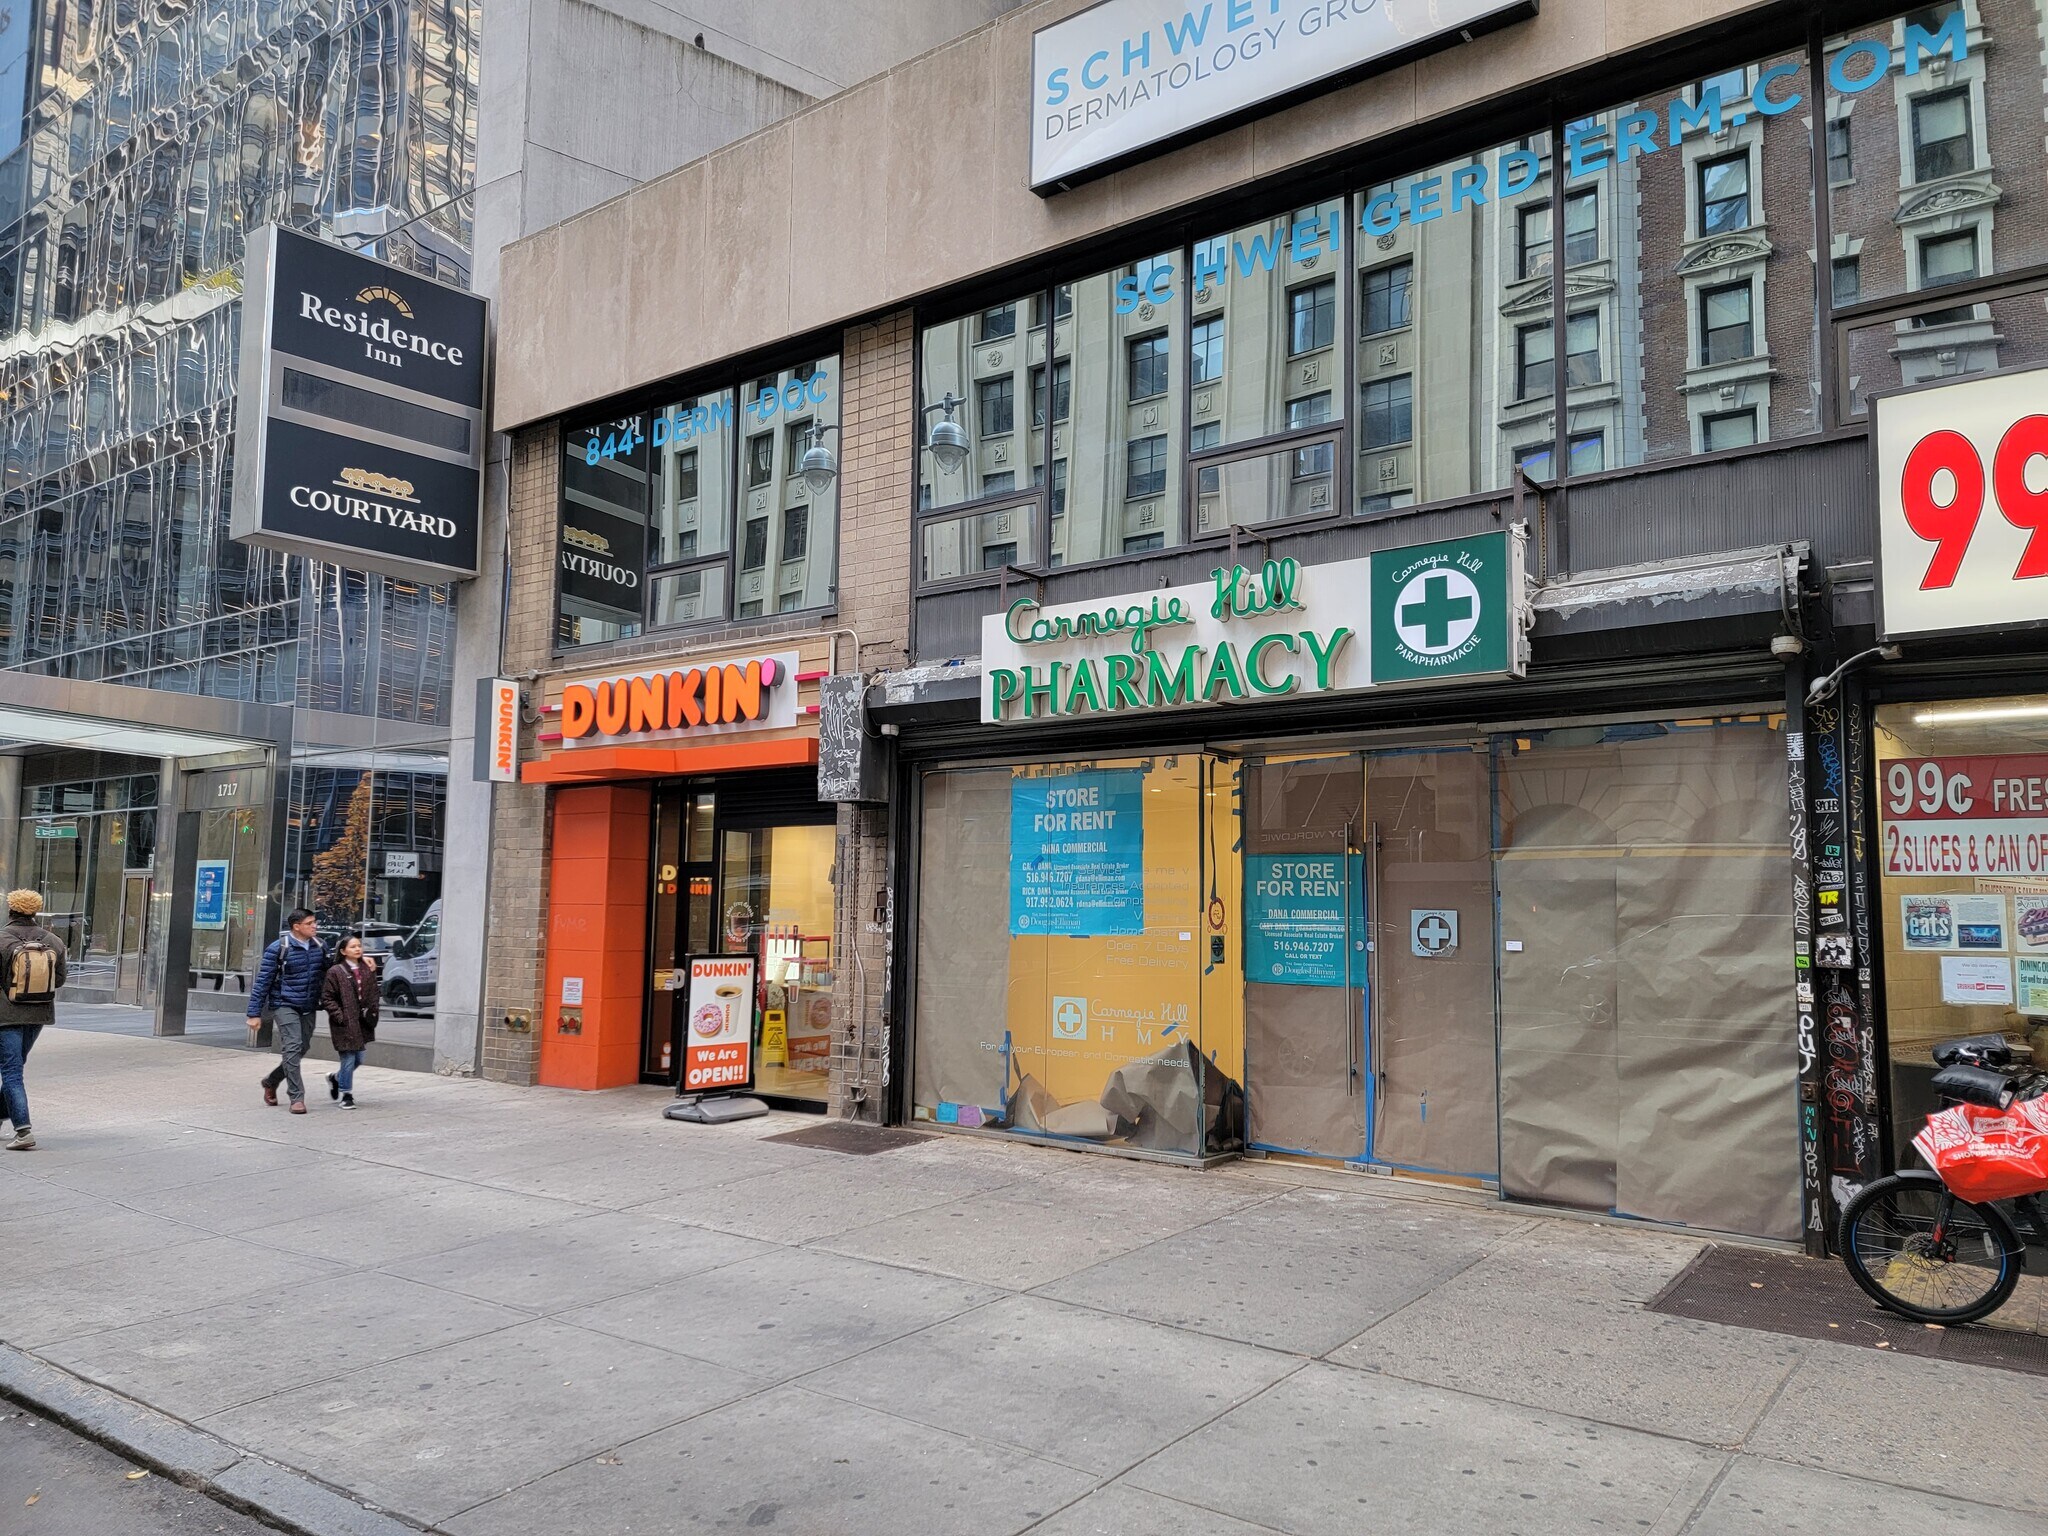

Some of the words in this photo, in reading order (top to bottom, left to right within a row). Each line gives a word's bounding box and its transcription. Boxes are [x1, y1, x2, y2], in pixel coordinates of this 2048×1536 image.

[1045, 19, 1286, 141] DERMATOLOGY
[299, 290, 464, 368] Residence
[364, 341, 403, 368] Inn
[289, 484, 457, 540] COURTYARD
[1392, 553, 1449, 583] Carnegie
[1456, 551, 1483, 574] Hill
[1004, 596, 1195, 656] Carnegie
[1209, 555, 1307, 622] Hill
[1394, 634, 1482, 667] PARAPHARMACIE
[988, 626, 1355, 722] PHARMACY
[217, 783, 238, 797] 1717
[1045, 787, 1099, 809] STORE
[1993, 777, 2048, 812] FRE
[1034, 813, 1067, 832] FOR
[1070, 810, 1117, 831] RENT
[1041, 844, 1060, 854] DANA
[1062, 841, 1108, 854] COMMERCIAL
[1887, 825, 1901, 872] 2
[1903, 834, 1962, 873] SLICES
[1968, 834, 1979, 873] &
[1985, 834, 2021, 872] CAN
[1271, 863, 1335, 879] STORE
[1256, 881, 1295, 896] FOR
[1268, 909, 1288, 919] DANA
[1291, 909, 1340, 920] COMMERCIAL
[1909, 913, 1949, 936] eats
[1106, 939, 1138, 952] Open
[1156, 941, 1189, 954] Days
[1273, 941, 1335, 952] 516.946.7207
[1139, 956, 1189, 969] Delivery
[1091, 999, 1156, 1027] Carnegie
[1160, 1002, 1189, 1023] Hill
[696, 1050, 715, 1062] We
[718, 1049, 738, 1060] Are
[980, 1041, 997, 1051] For
[1011, 1045, 1032, 1054] your
[1034, 1046, 1080, 1058] European
[1104, 1051, 1155, 1065] Domestic
[1157, 1058, 1190, 1068] needs
[688, 1065, 744, 1085] OPEN!!
